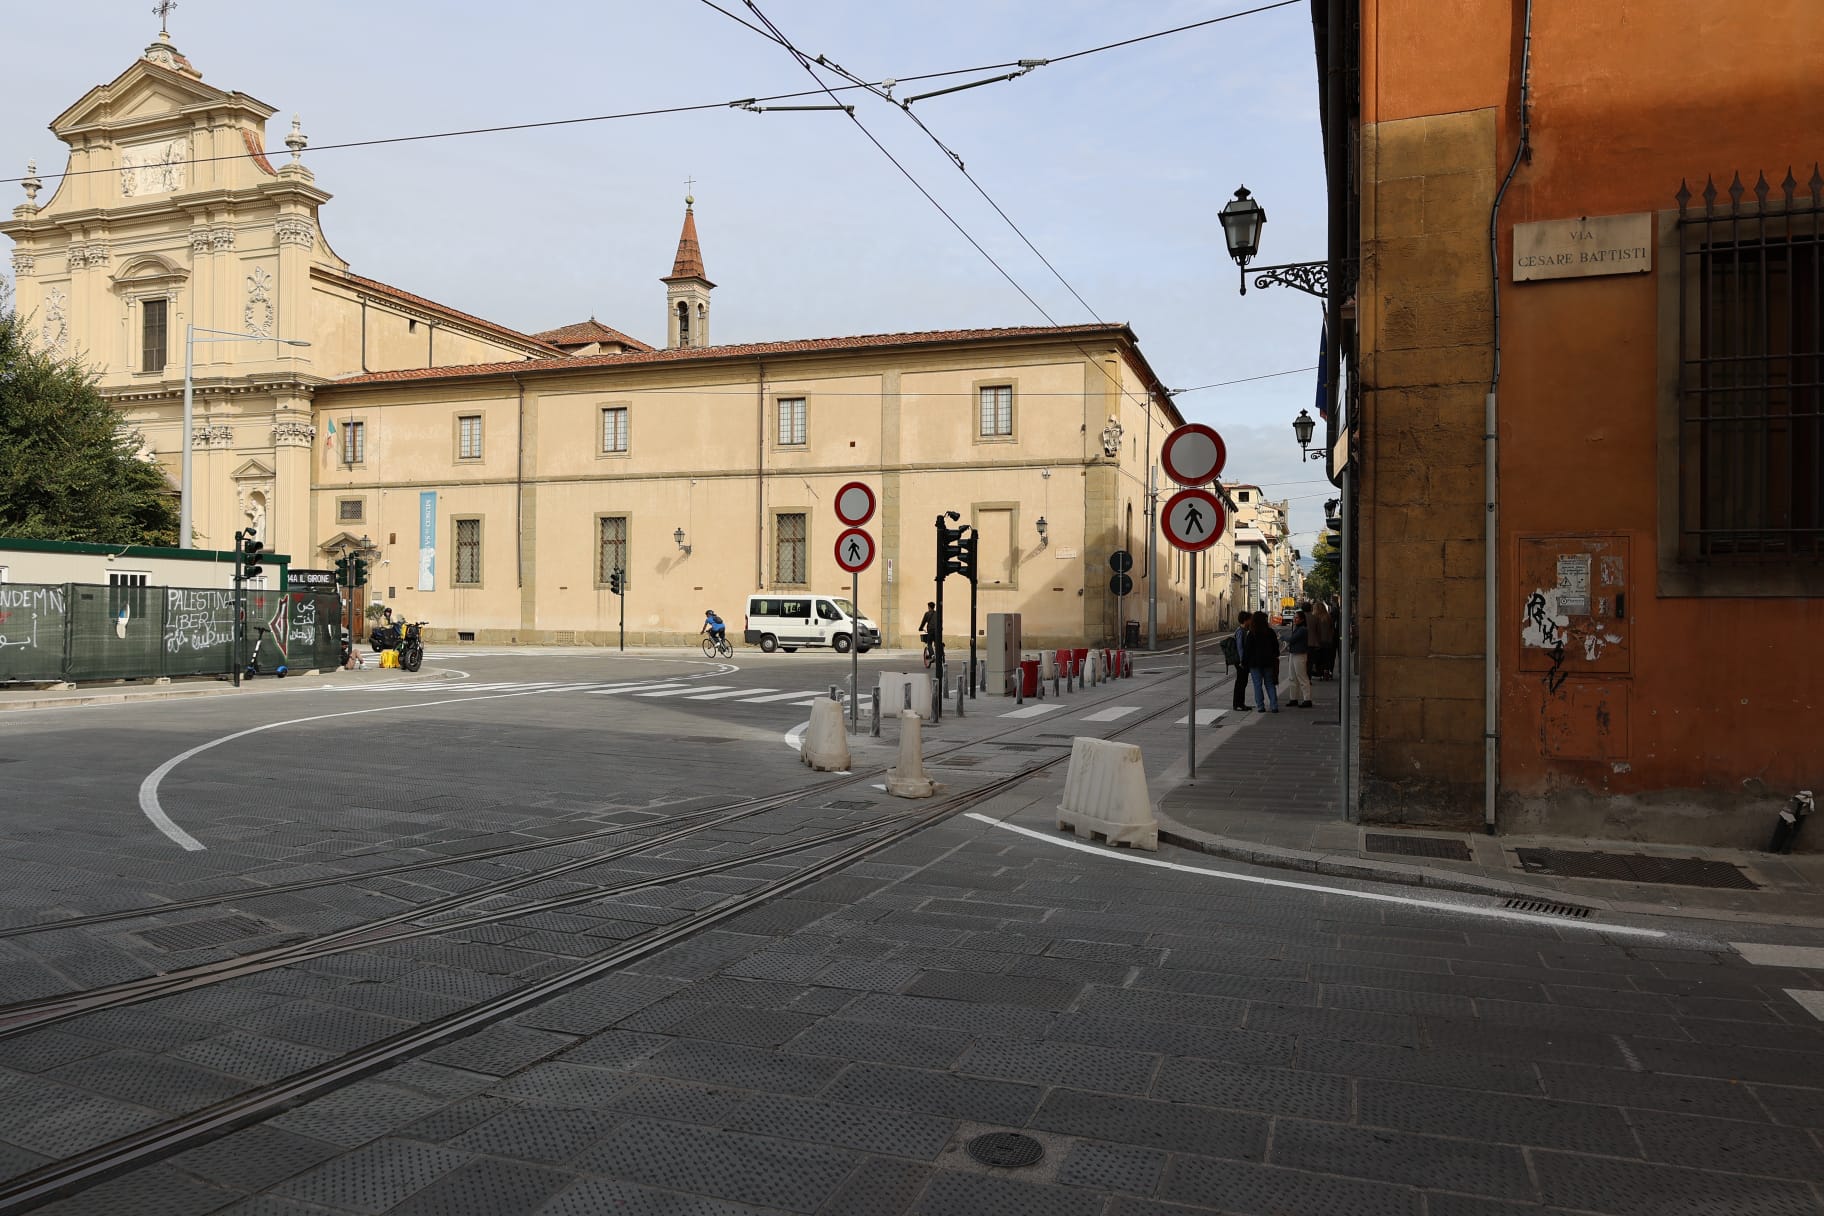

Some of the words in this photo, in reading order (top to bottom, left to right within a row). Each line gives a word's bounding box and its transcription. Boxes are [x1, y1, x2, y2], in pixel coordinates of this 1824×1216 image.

[1569, 231, 1593, 240] VIA
[1518, 253, 1573, 267] CESARE
[1580, 247, 1646, 263] BATTISTI
[299, 574, 306, 583] IL
[307, 574, 330, 583] GIRONE
[168, 589, 235, 610] PALESTINA
[166, 610, 233, 631] LIBERA
